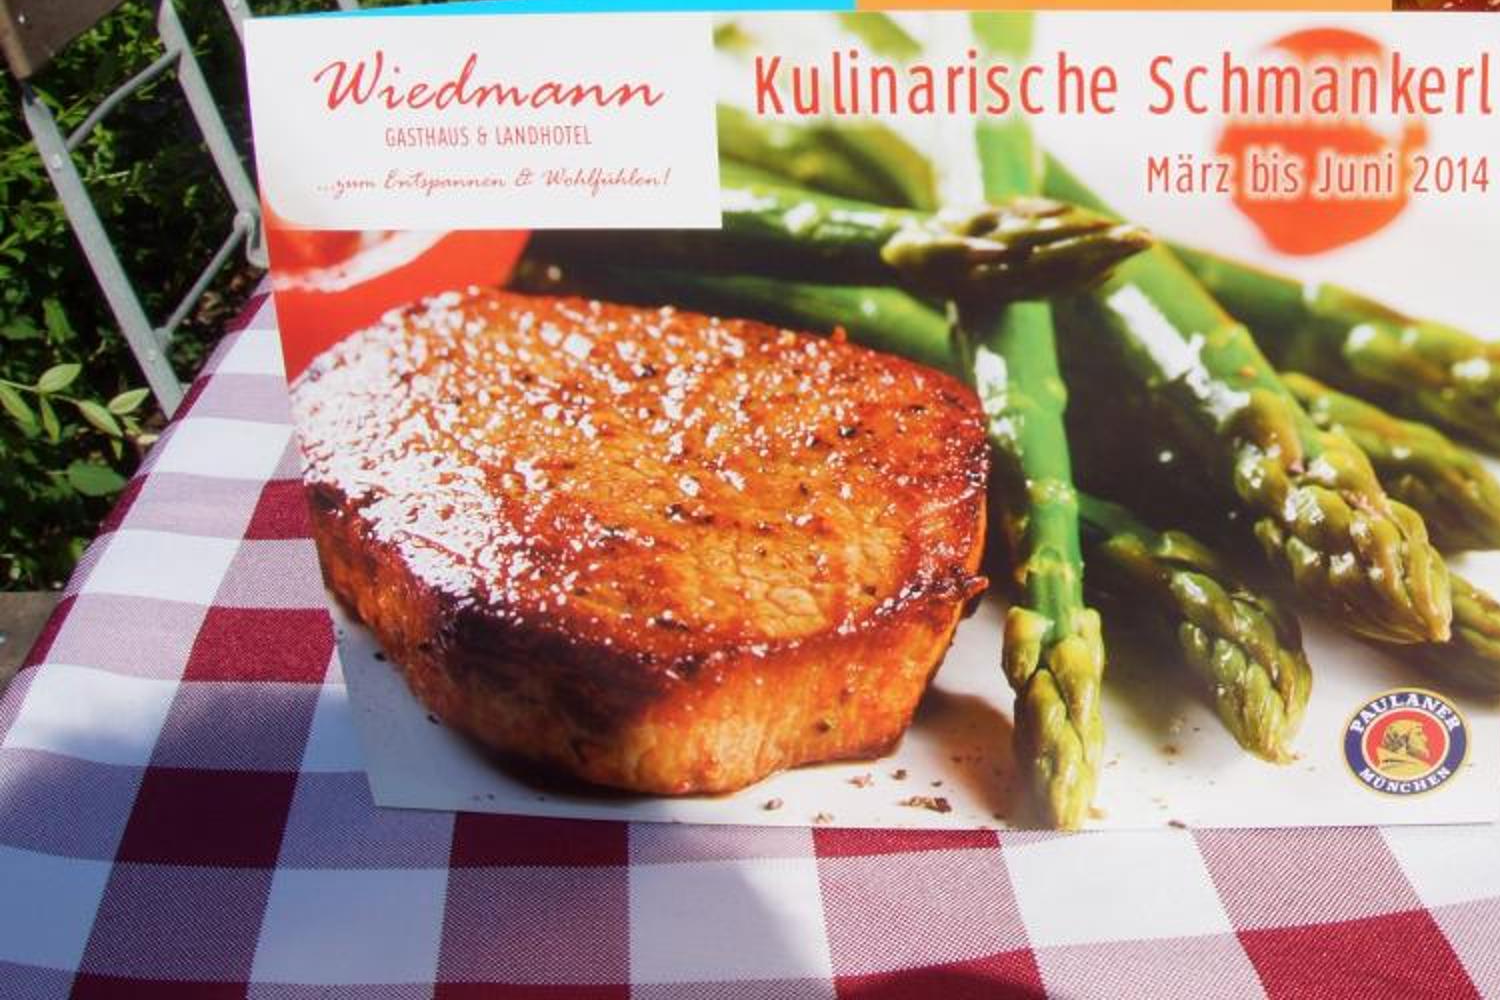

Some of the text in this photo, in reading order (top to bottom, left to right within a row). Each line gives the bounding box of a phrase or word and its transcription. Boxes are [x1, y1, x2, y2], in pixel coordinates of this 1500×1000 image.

[313, 50, 664, 110] Wiedmann
[754, 49, 1492, 116] Kulinarische Schmankerl
[385, 124, 593, 148] GASTHAUS & LANDHOTEL
[383, 167, 506, 197] Entspannen
[542, 166, 672, 197] Wohlfühlen!
[1147, 153, 1490, 193] März bis Juni 2014
[1350, 692, 1462, 734] PAULANER
[1359, 766, 1452, 794] MÜNCHEN
